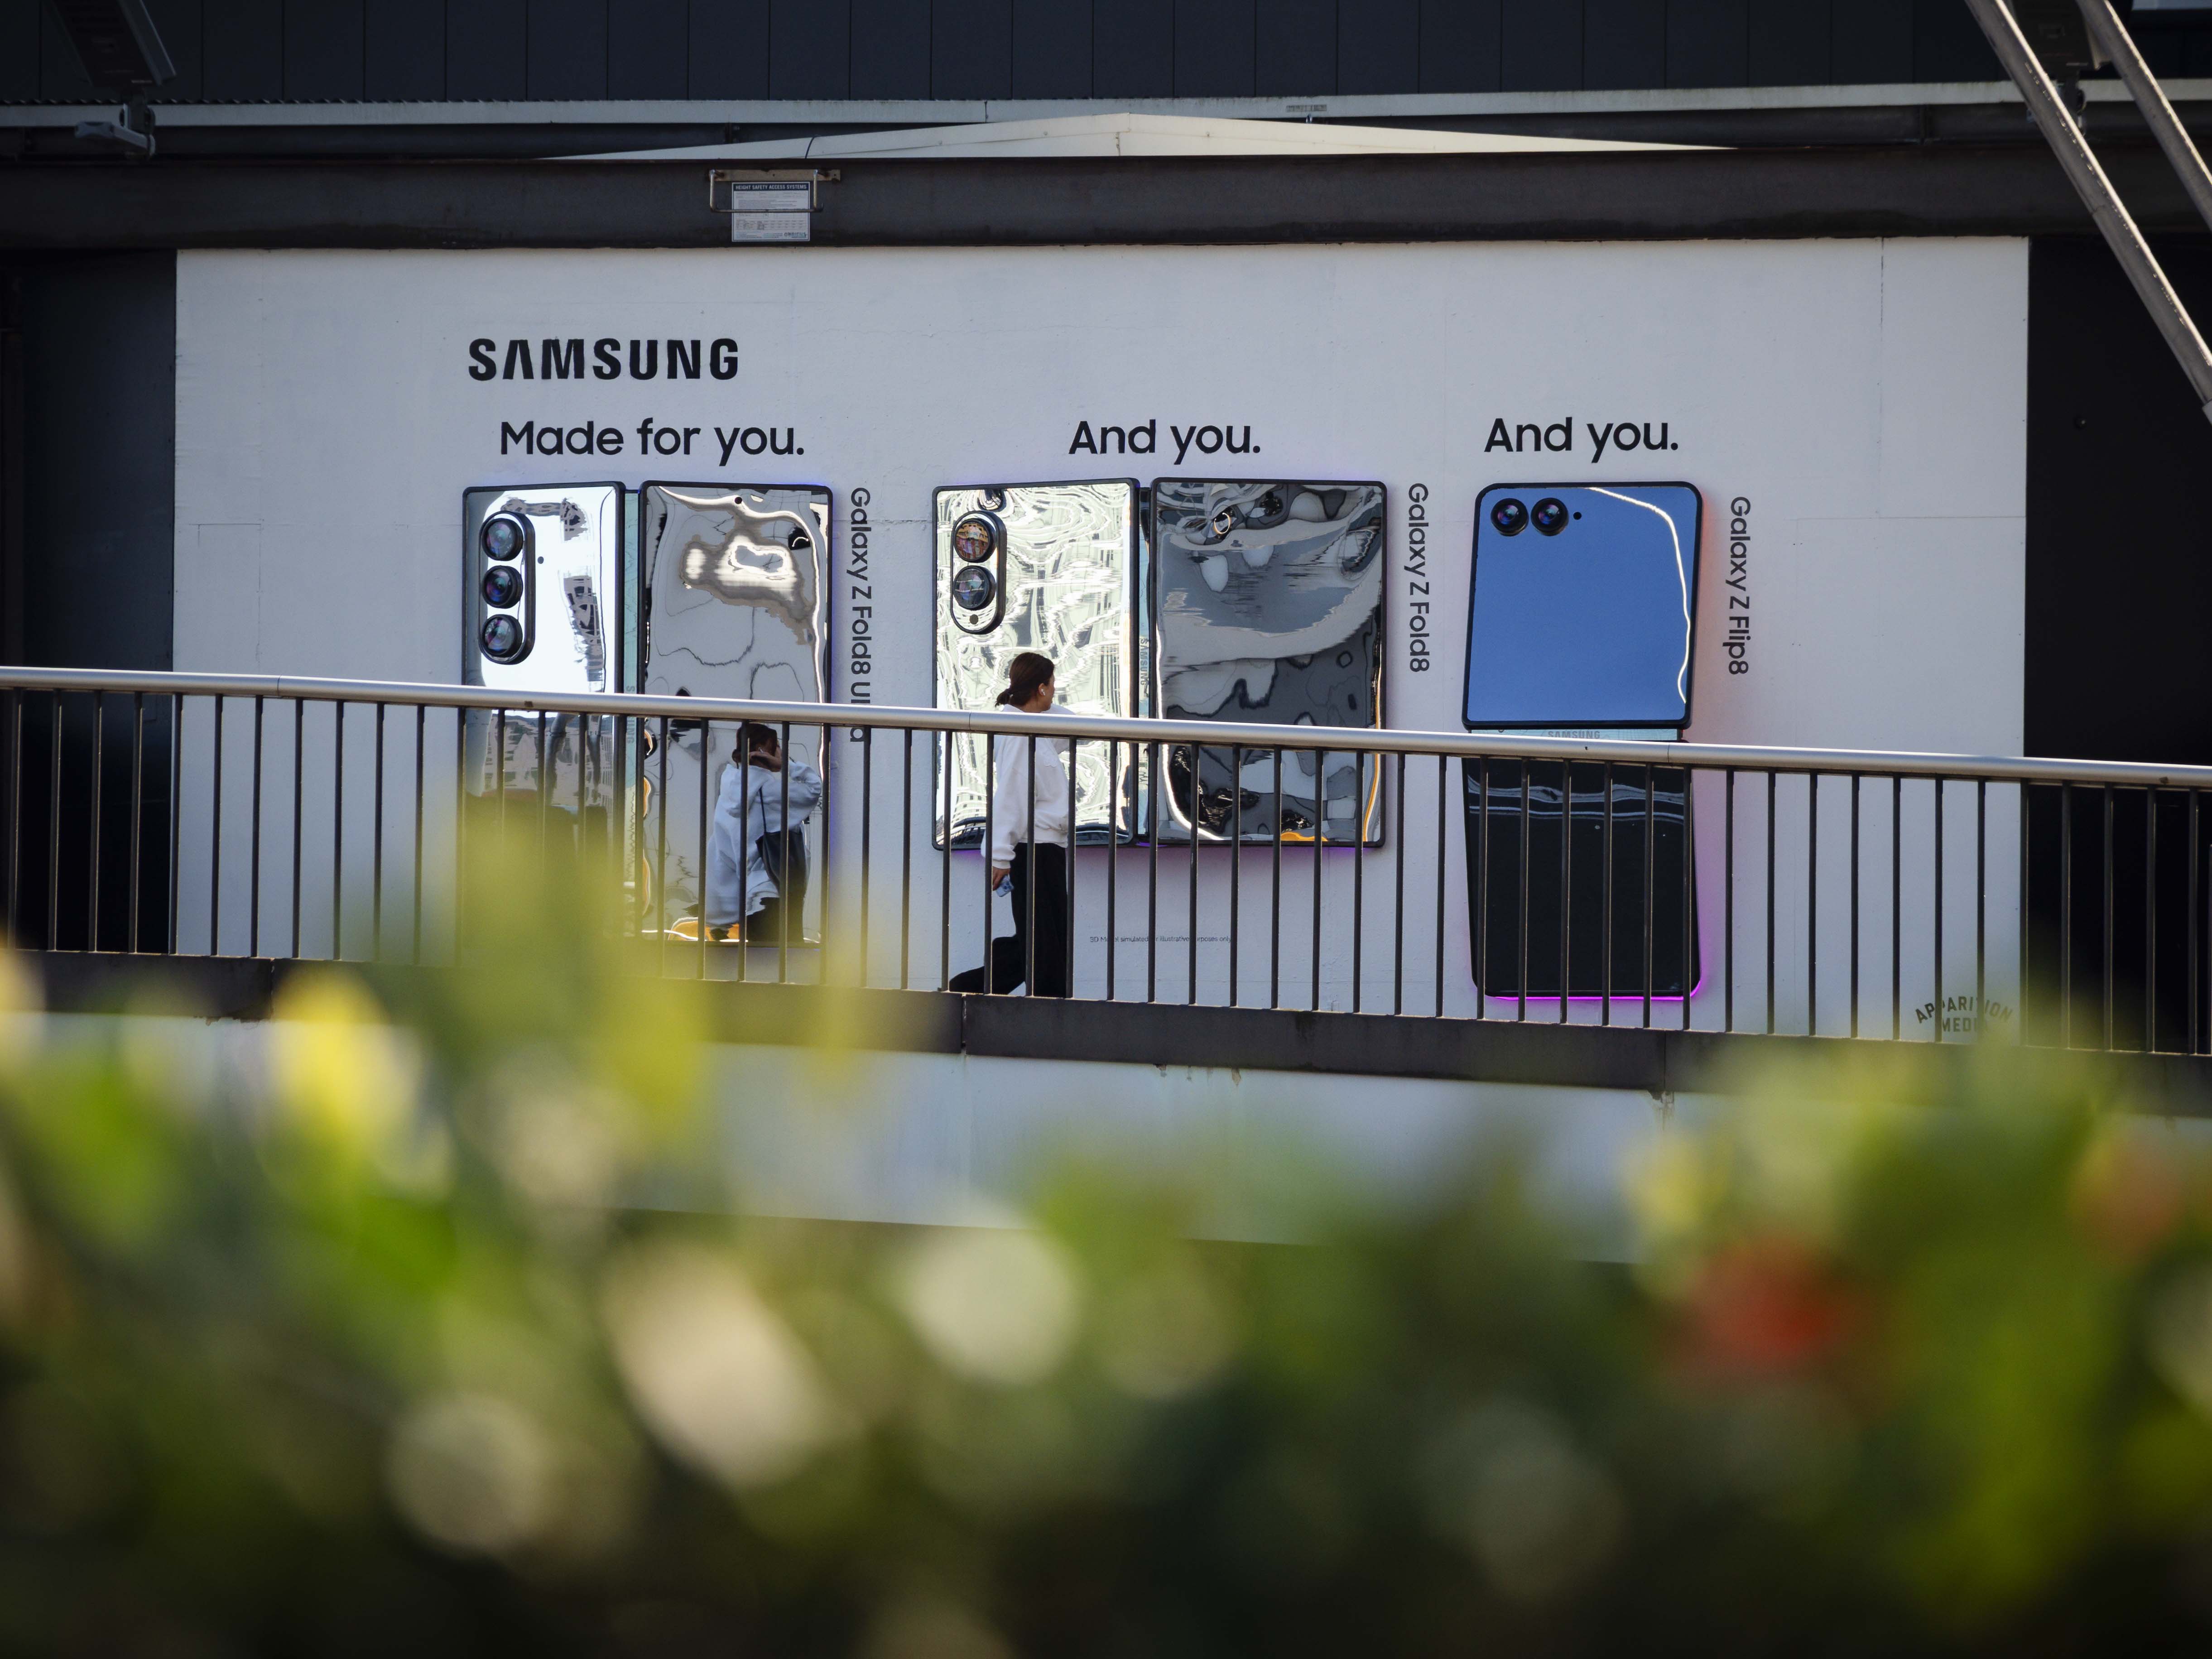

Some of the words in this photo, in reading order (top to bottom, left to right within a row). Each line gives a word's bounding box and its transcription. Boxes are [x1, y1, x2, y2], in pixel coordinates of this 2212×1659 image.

[468, 338, 738, 381] SAMSUNG
[501, 421, 624, 456] Made
[636, 417, 701, 455] for
[714, 427, 805, 466] you.
[1069, 419, 1156, 454] And
[1170, 425, 1261, 465] you.
[1484, 416, 1572, 452] And
[1587, 422, 1679, 463] you.
[846, 487, 871, 581] Galaxy
[1404, 483, 1429, 577] Galaxy
[1726, 497, 1751, 591] Galaxy
[852, 586, 872, 600] Z
[1409, 582, 1429, 596] Z
[1729, 596, 1750, 609] Z
[850, 606, 872, 675] Fold8
[1409, 602, 1430, 673] Fold8
[1722, 616, 1751, 675] Flip8
[850, 682, 870, 742] Ula
[1915, 996, 2012, 1024] APARIION
